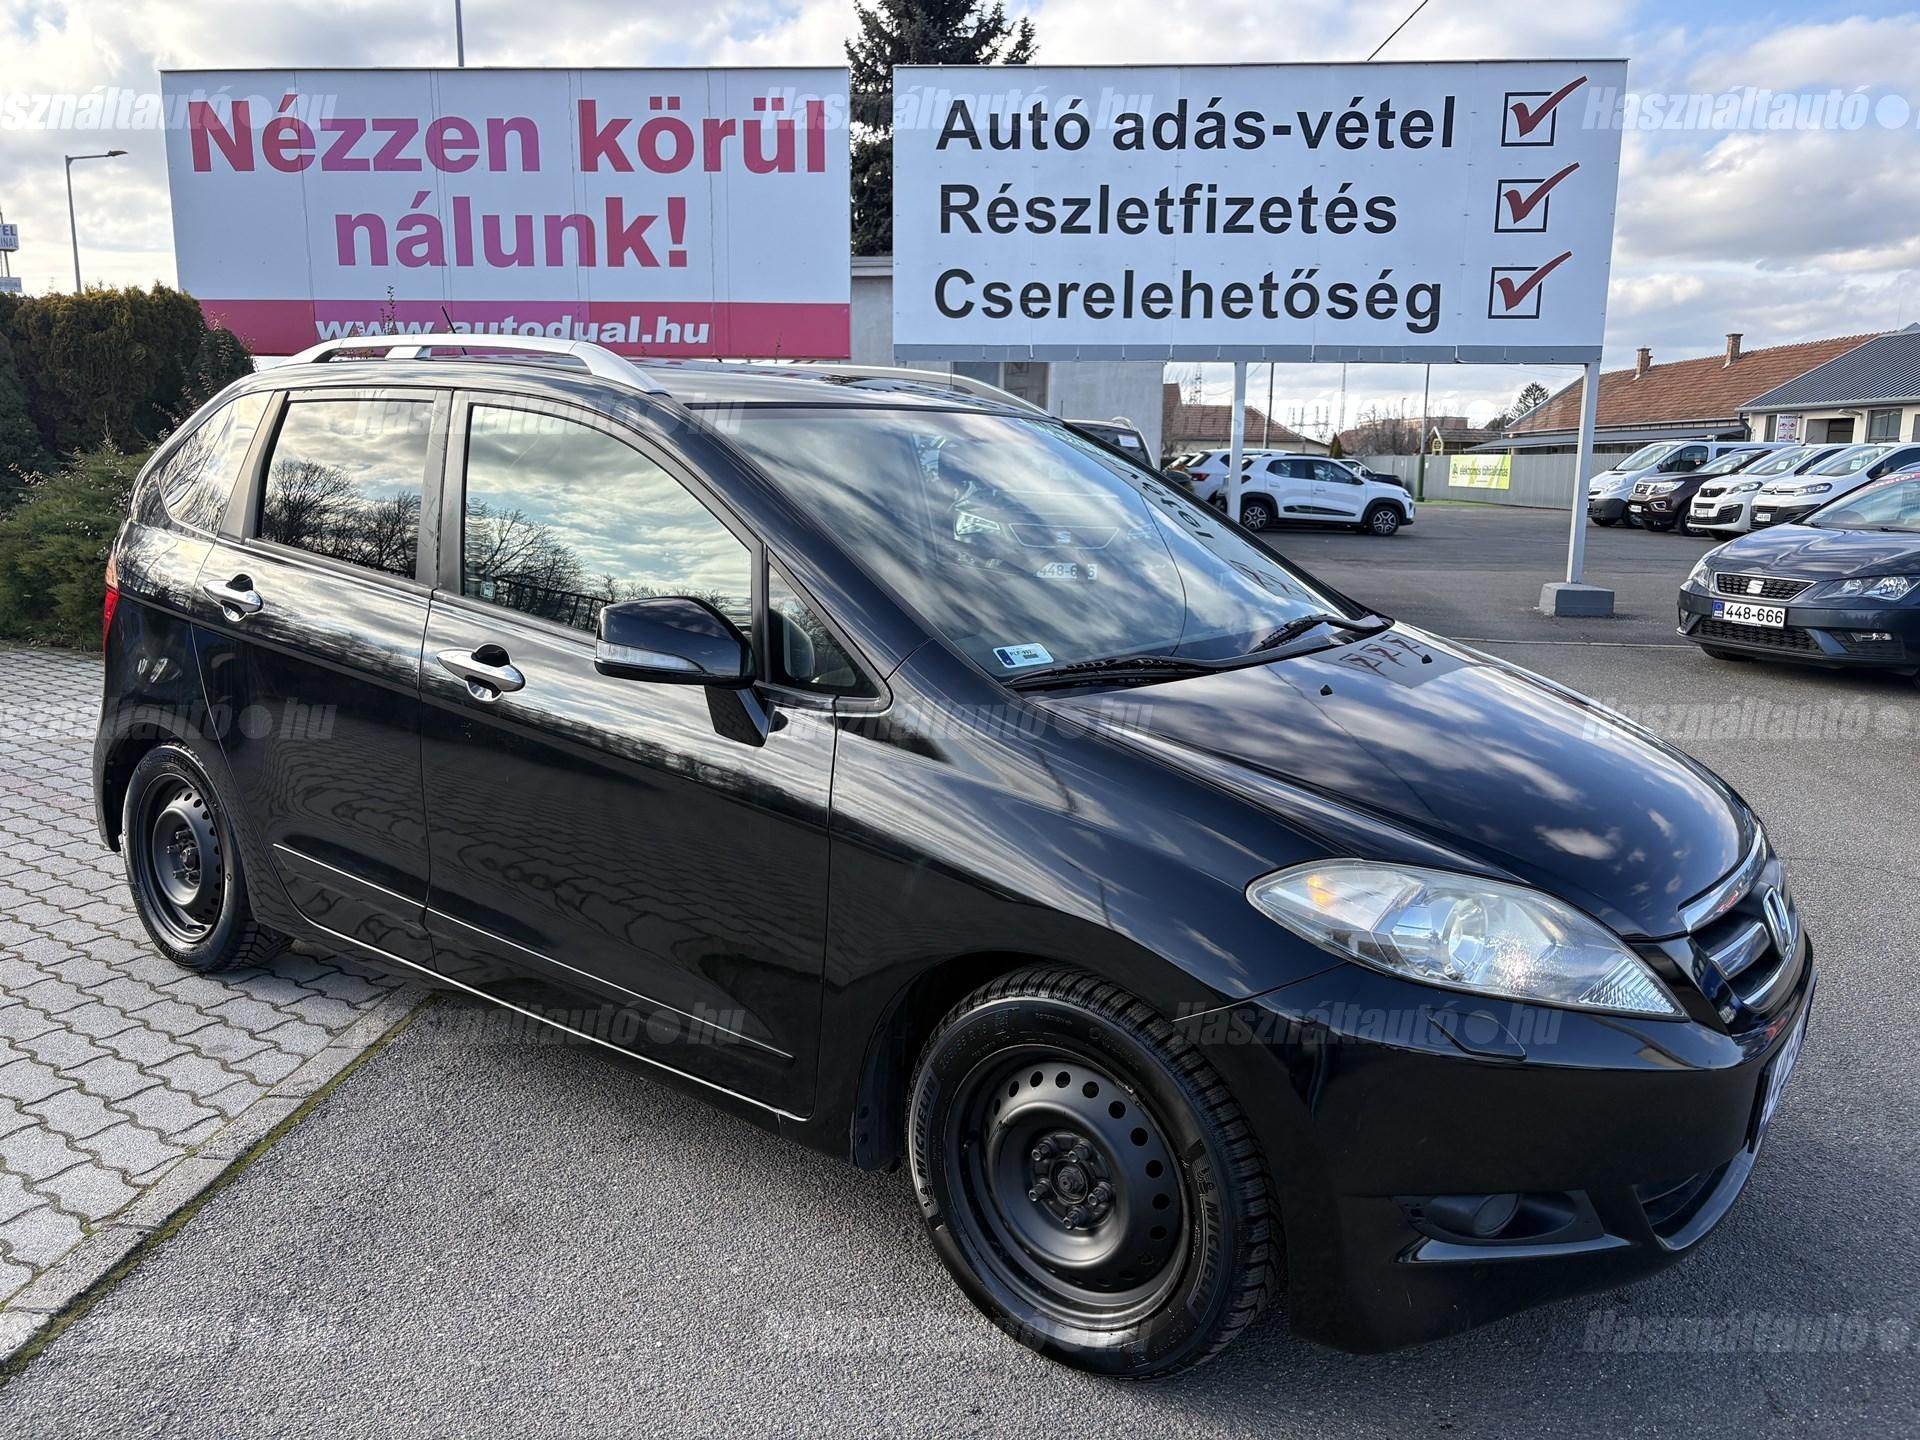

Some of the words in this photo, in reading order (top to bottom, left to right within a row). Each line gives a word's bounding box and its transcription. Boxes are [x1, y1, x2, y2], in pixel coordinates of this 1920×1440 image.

[188, 94, 541, 173] Nézzen
[578, 96, 826, 174] körül
[936, 98, 1091, 151] Autó
[1113, 95, 1456, 151] adás-vétel
[335, 190, 688, 269] nálunk!
[940, 181, 1398, 235] Részletfizetés
[934, 266, 1441, 334] Cserelehetőség
[315, 314, 710, 345] wwwautodual.hu
[1039, 563, 1097, 578] 448-66
[1726, 604, 1784, 624] 448-666
[913, 1074, 939, 1180] MICHELIN
